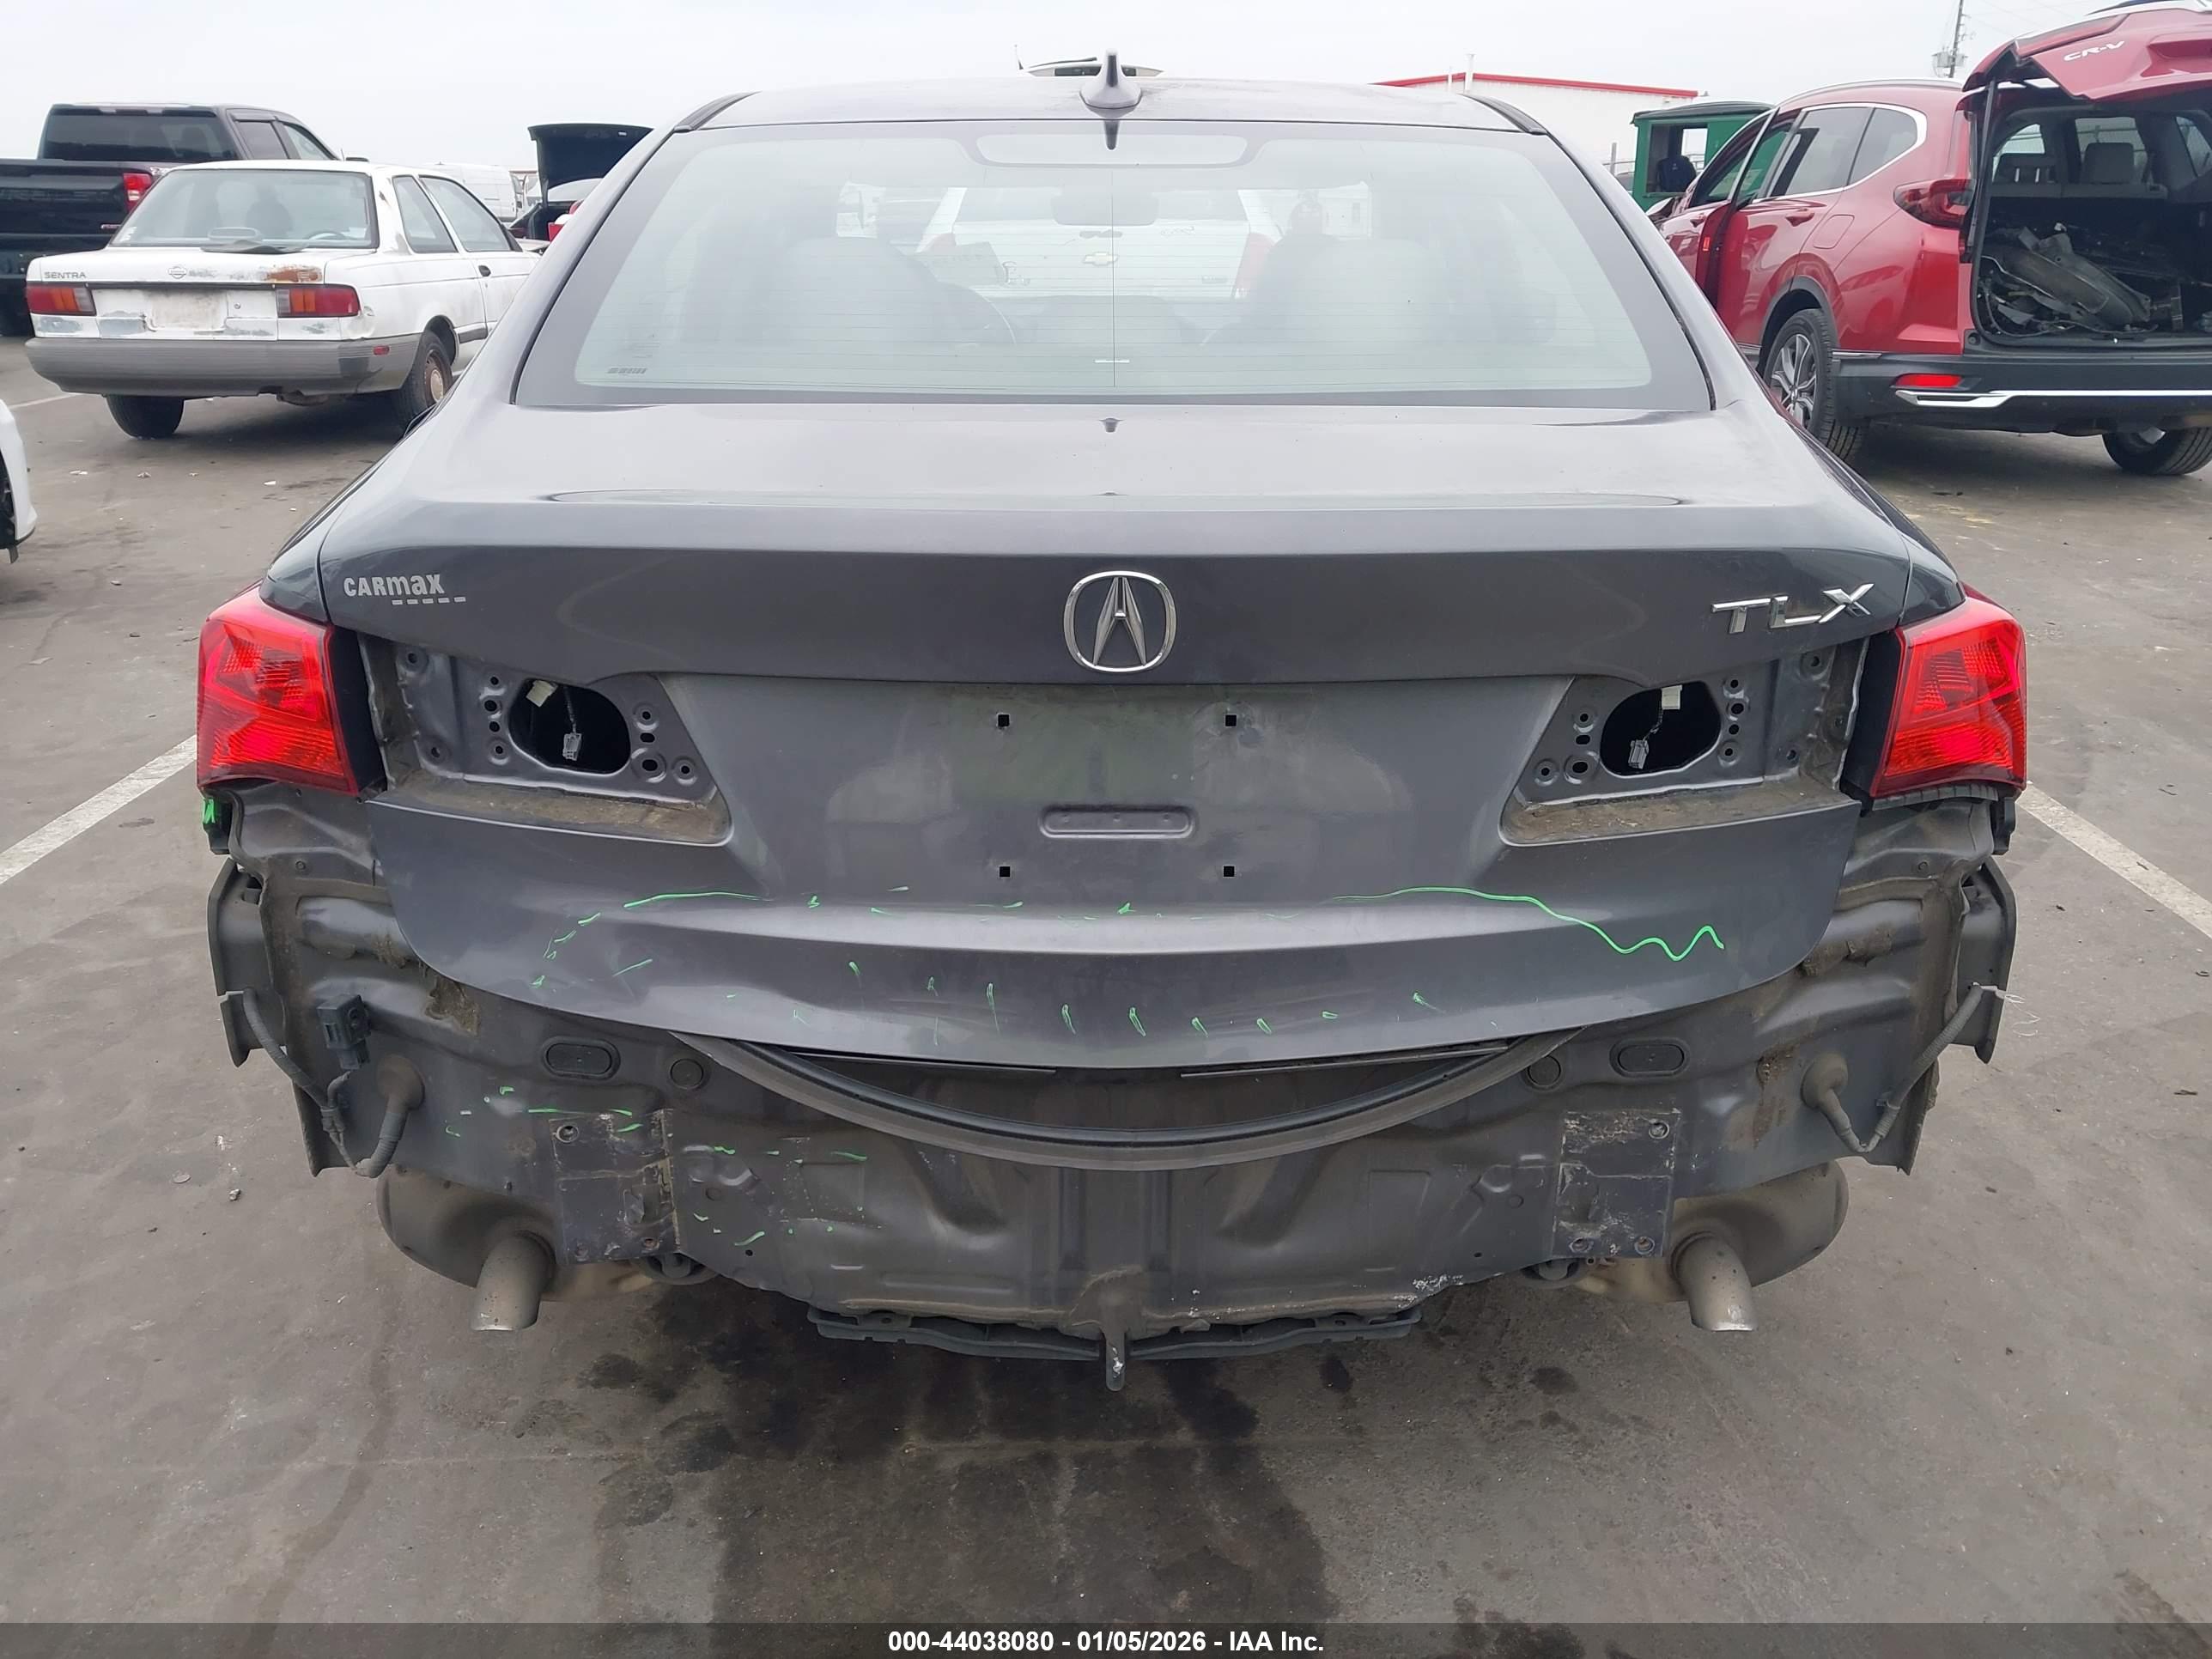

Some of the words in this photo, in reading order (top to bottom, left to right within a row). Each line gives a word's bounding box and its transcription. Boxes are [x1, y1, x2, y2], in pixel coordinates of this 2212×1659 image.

[2063, 40, 2125, 62] CR-V
[44, 271, 86, 280] SENTRA
[1711, 583, 1875, 635] TLX
